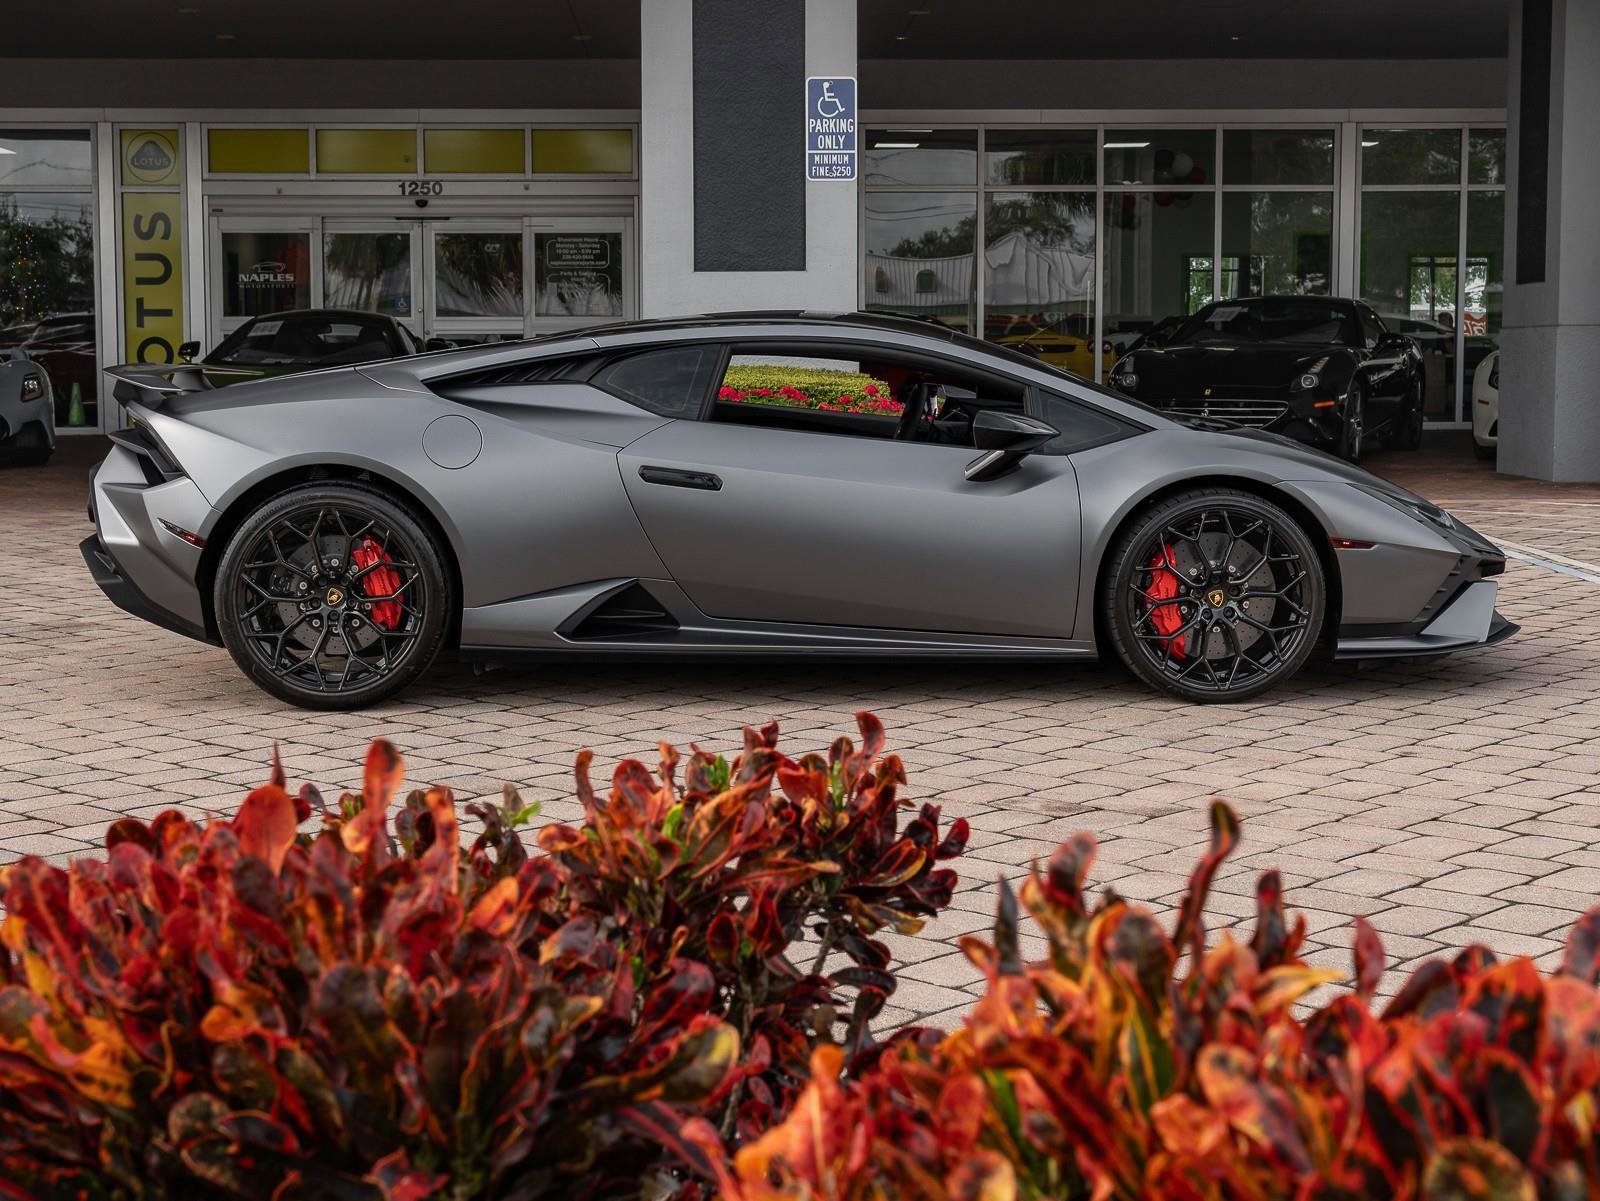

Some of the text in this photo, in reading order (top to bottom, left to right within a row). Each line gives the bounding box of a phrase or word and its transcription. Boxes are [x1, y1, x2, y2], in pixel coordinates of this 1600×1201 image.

[809, 118, 854, 133] PARKING
[817, 134, 846, 149] ONLY
[134, 157, 169, 166] LOTUS
[814, 154, 849, 164] MINIMUM
[812, 165, 851, 177] FINE $250
[398, 181, 443, 196] 1250
[239, 273, 294, 282] NAPLES
[133, 211, 175, 364] OTUS
